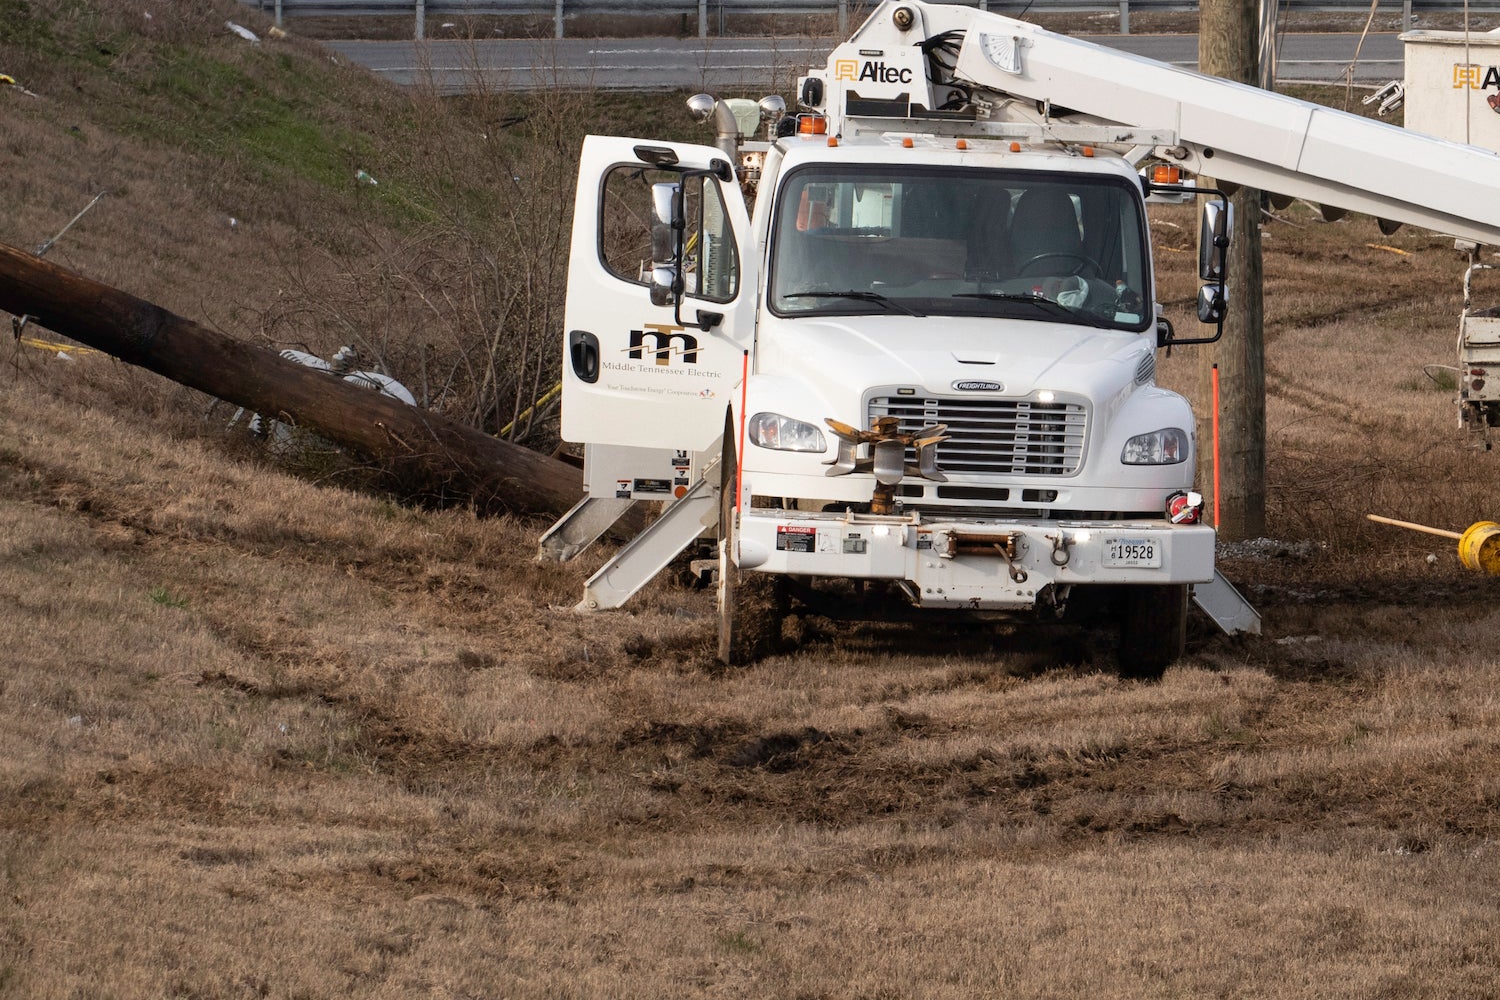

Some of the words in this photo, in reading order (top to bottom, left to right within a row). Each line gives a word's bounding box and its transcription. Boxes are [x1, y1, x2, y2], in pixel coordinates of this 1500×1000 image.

[858, 61, 913, 84] Altec
[601, 361, 636, 372] Middle
[638, 364, 685, 377] Tennessee
[687, 368, 722, 379] Electric
[1118, 545, 1153, 560] 19528
